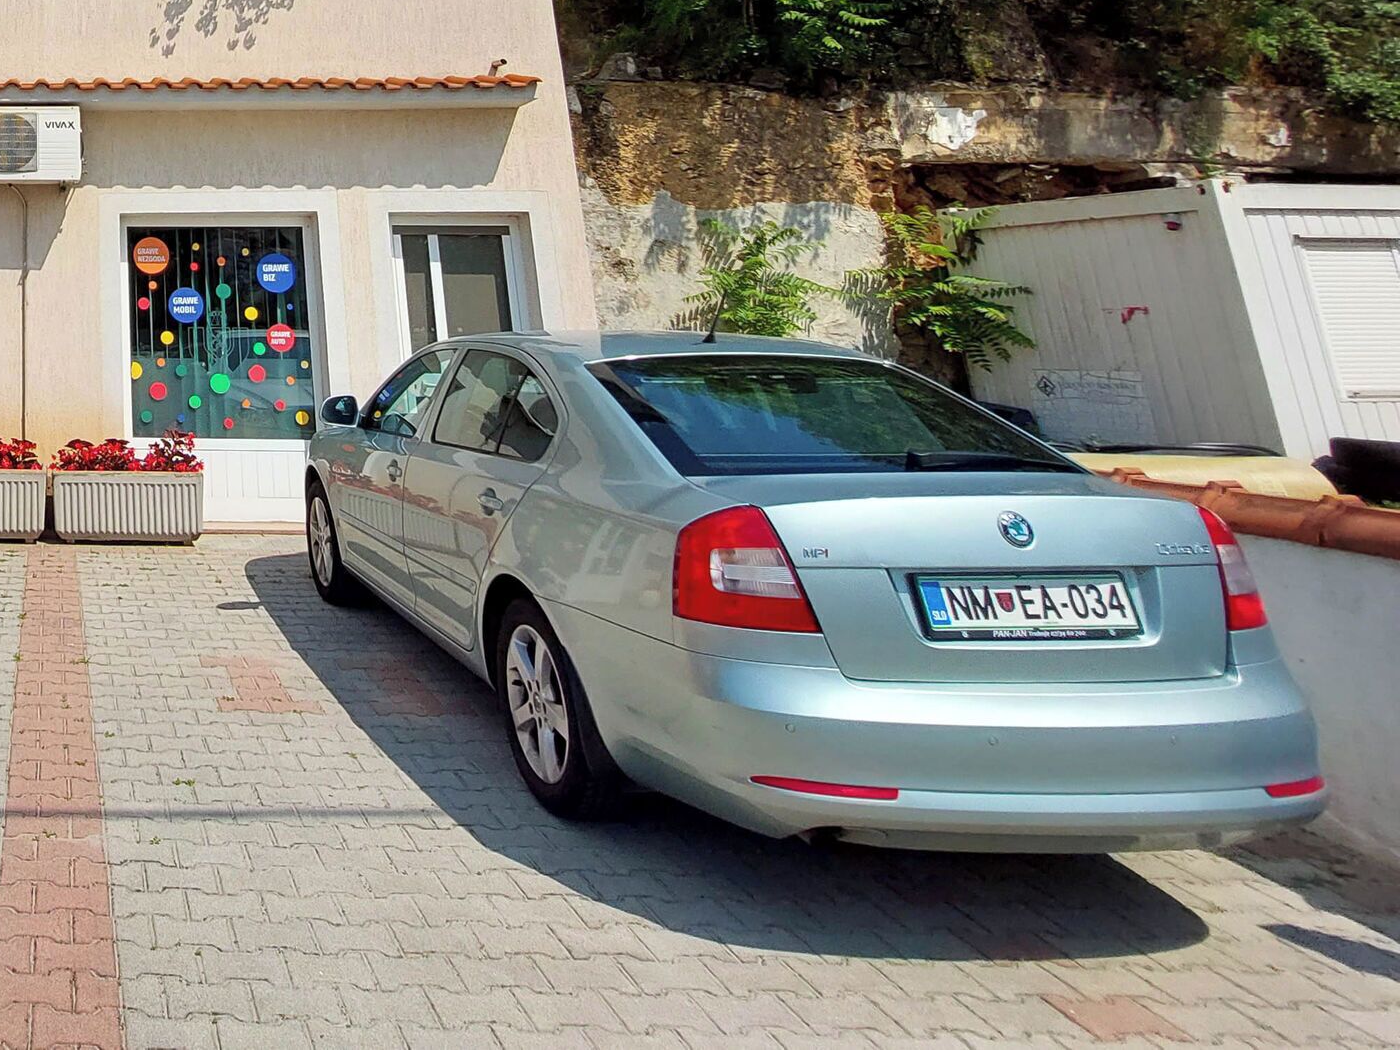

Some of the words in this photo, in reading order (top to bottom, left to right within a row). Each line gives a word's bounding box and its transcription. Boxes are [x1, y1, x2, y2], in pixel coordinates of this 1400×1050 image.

[45, 121, 75, 130] VIVAX
[263, 264, 289, 272] GRAWE
[263, 274, 276, 282] BIZ
[173, 297, 199, 305] GRAWE
[173, 306, 196, 314] MOBIL
[946, 585, 999, 621] NM
[1015, 583, 1127, 620] EA-034
[932, 610, 948, 621] SLO
